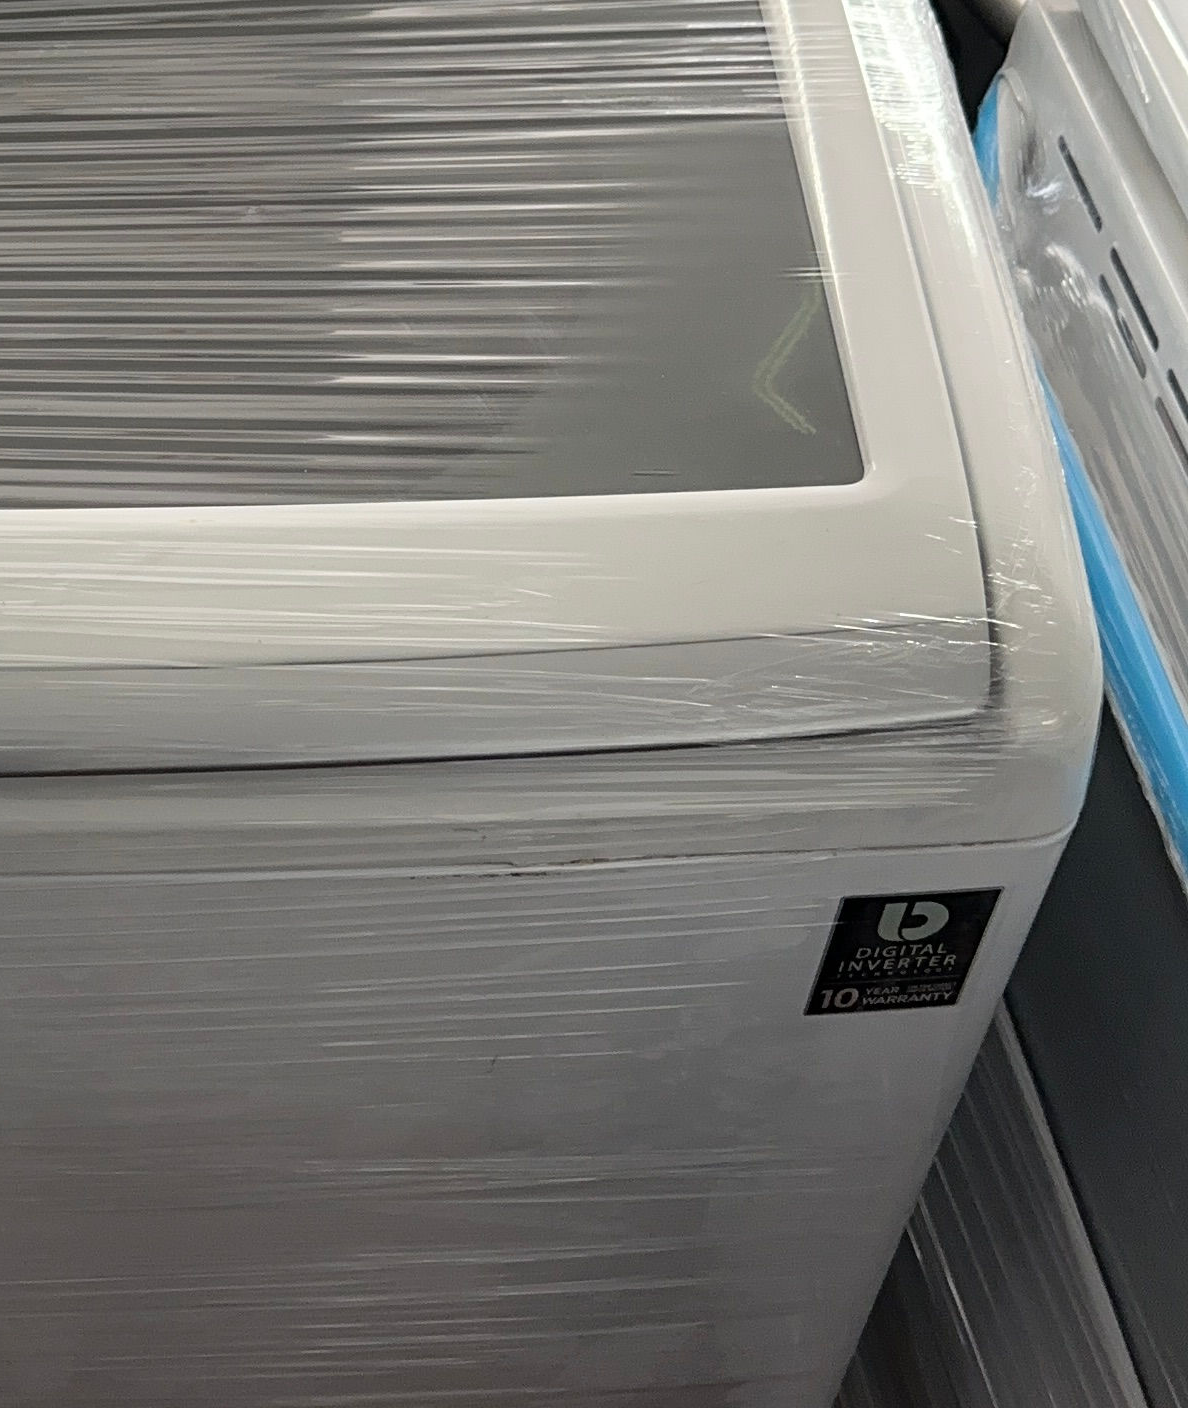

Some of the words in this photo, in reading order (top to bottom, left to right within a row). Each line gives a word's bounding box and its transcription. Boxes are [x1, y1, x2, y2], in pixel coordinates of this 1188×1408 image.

[855, 943, 948, 959] DIGITAL
[838, 954, 957, 973] INVERTER
[820, 987, 860, 1009] 10
[866, 986, 900, 995] YEAR
[862, 992, 954, 1006] WARRANTY
